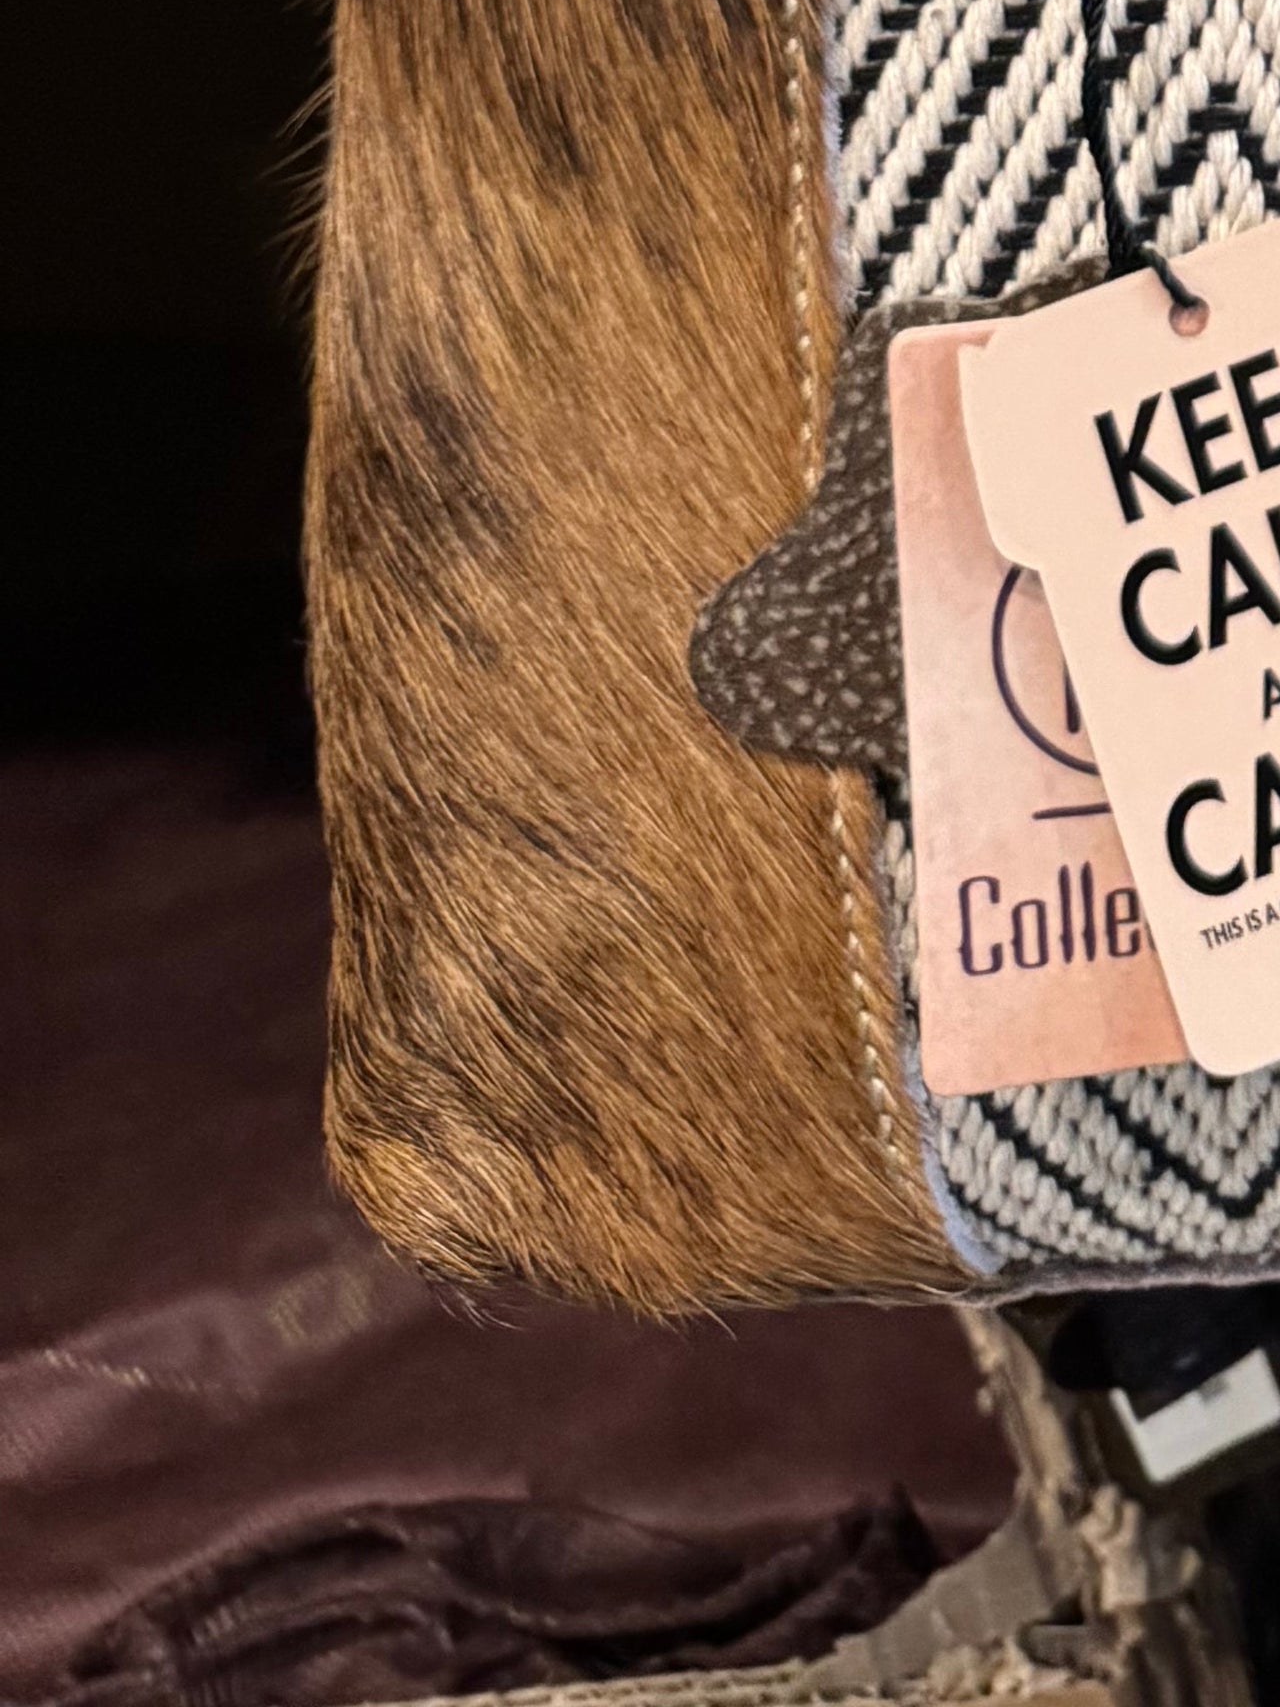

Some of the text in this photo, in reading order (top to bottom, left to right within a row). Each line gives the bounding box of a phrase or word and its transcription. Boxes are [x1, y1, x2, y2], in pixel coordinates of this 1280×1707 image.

[1200, 916, 1244, 950] THIS
[1245, 909, 1263, 932] IS
[1266, 903, 1280, 924] A
